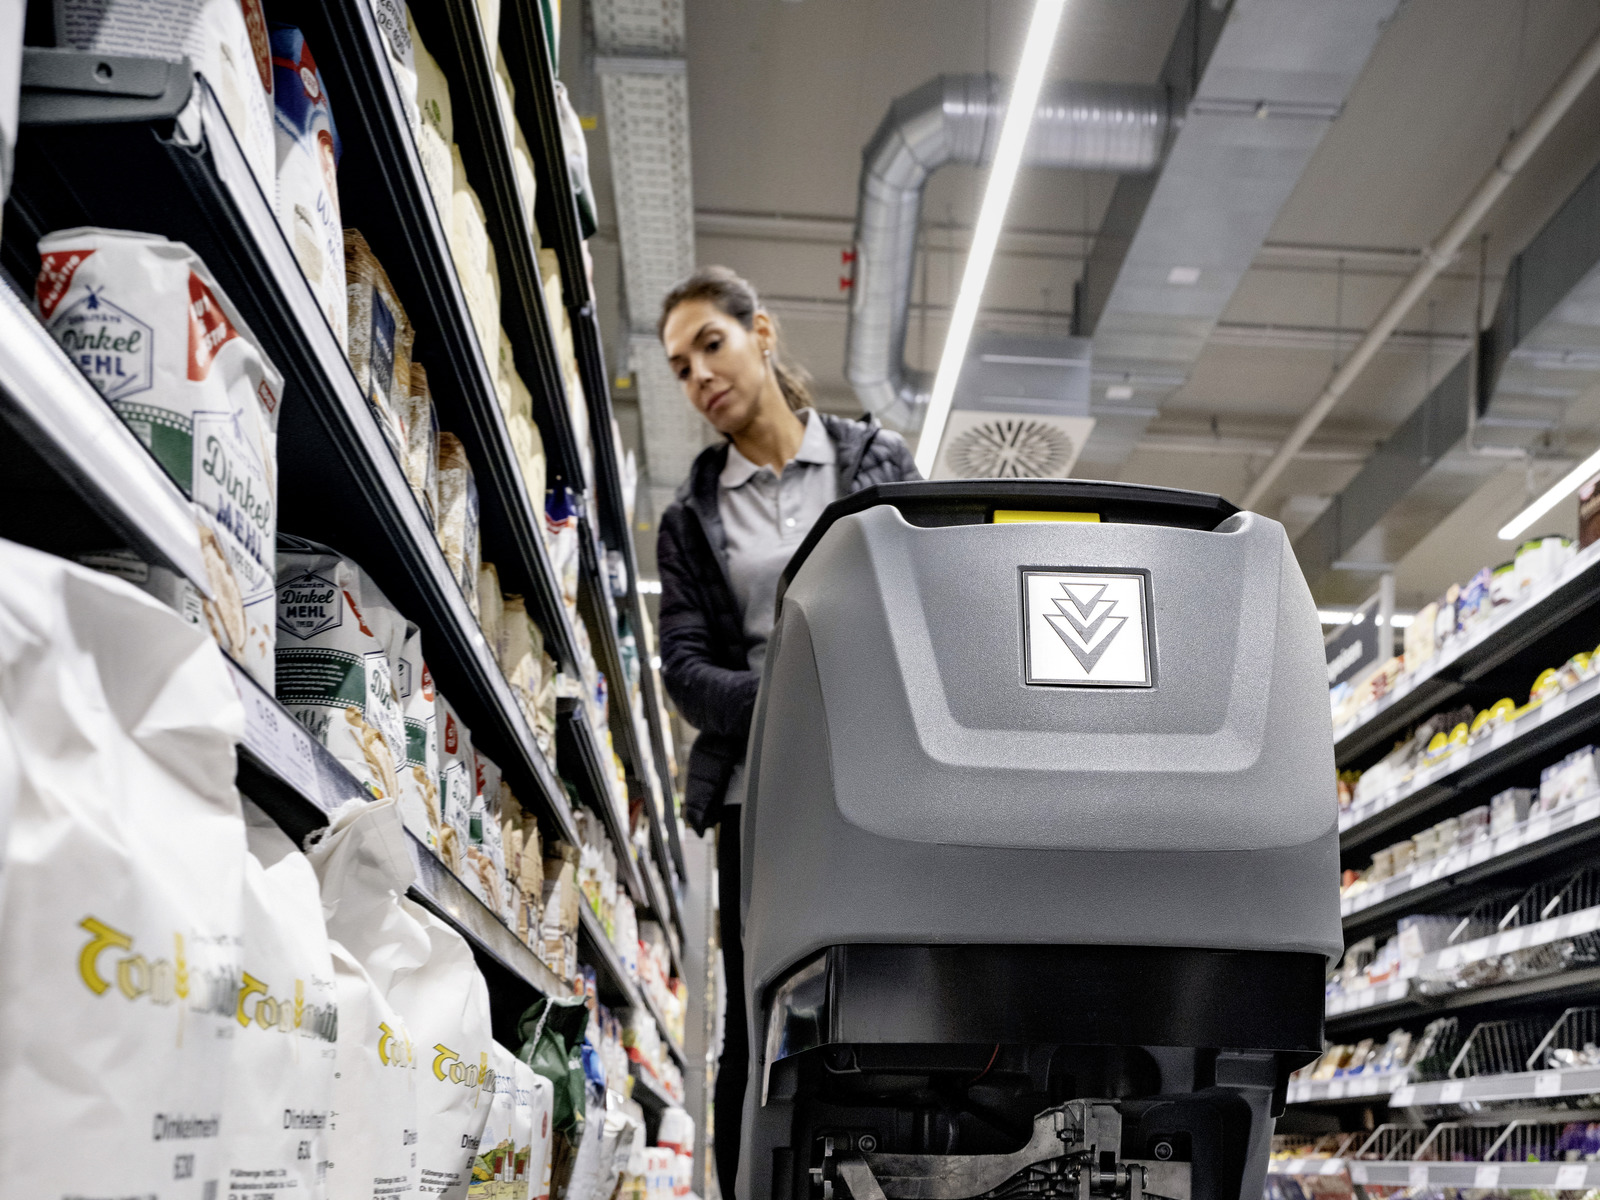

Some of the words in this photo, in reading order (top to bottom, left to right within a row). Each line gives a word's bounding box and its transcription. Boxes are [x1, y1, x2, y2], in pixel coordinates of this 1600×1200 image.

[62, 326, 142, 354] Dinkel
[202, 435, 271, 538] Dinkel
[279, 589, 335, 605] Dinkel
[286, 605, 327, 619] MEHL
